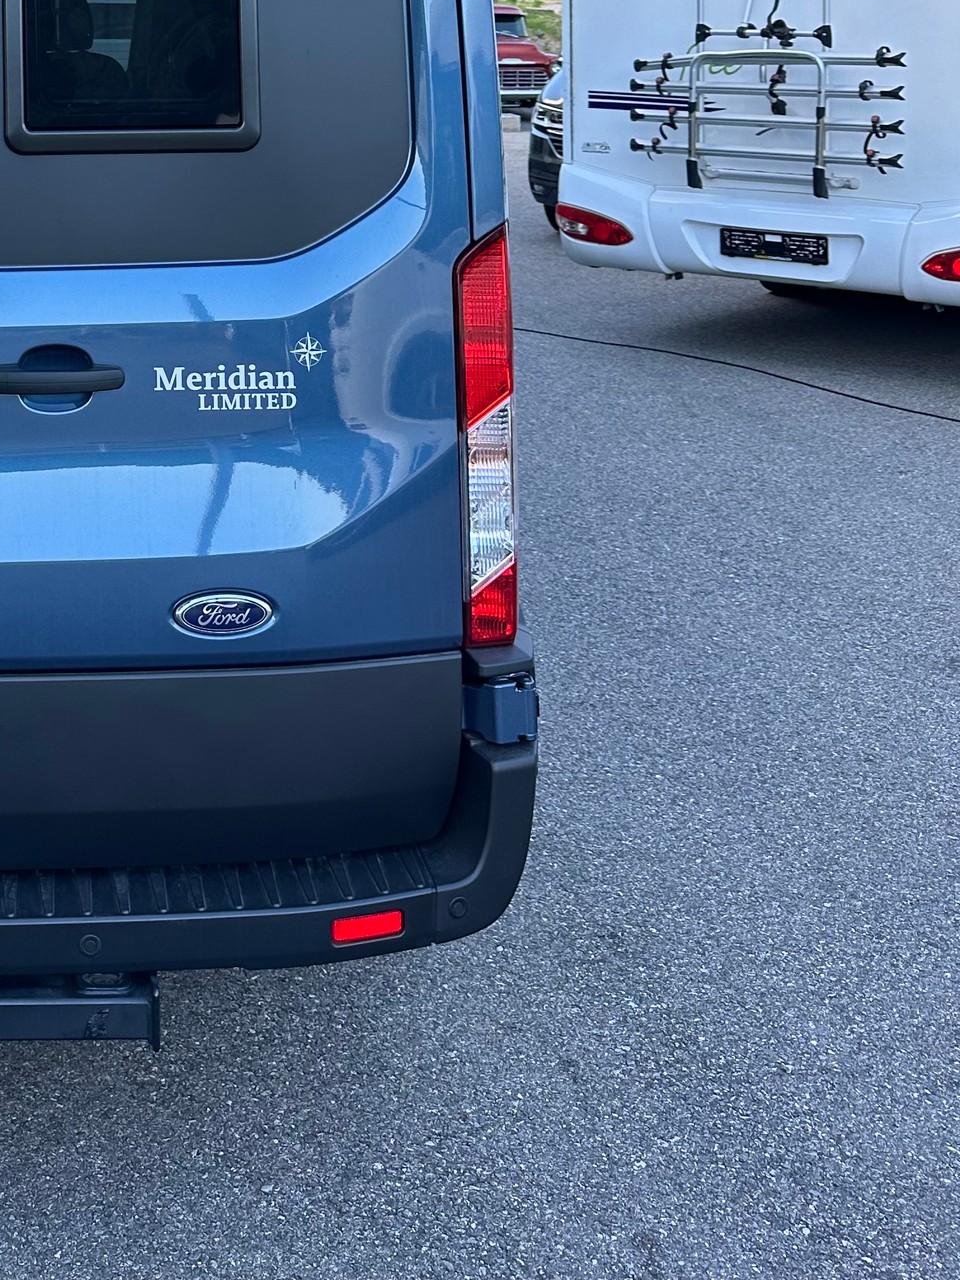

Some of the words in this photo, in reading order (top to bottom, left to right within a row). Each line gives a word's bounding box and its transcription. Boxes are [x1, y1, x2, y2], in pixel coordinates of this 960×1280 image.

[153, 365, 297, 391] Meridian
[198, 393, 298, 411] LIMITED
[198, 603, 251, 626] Ford
